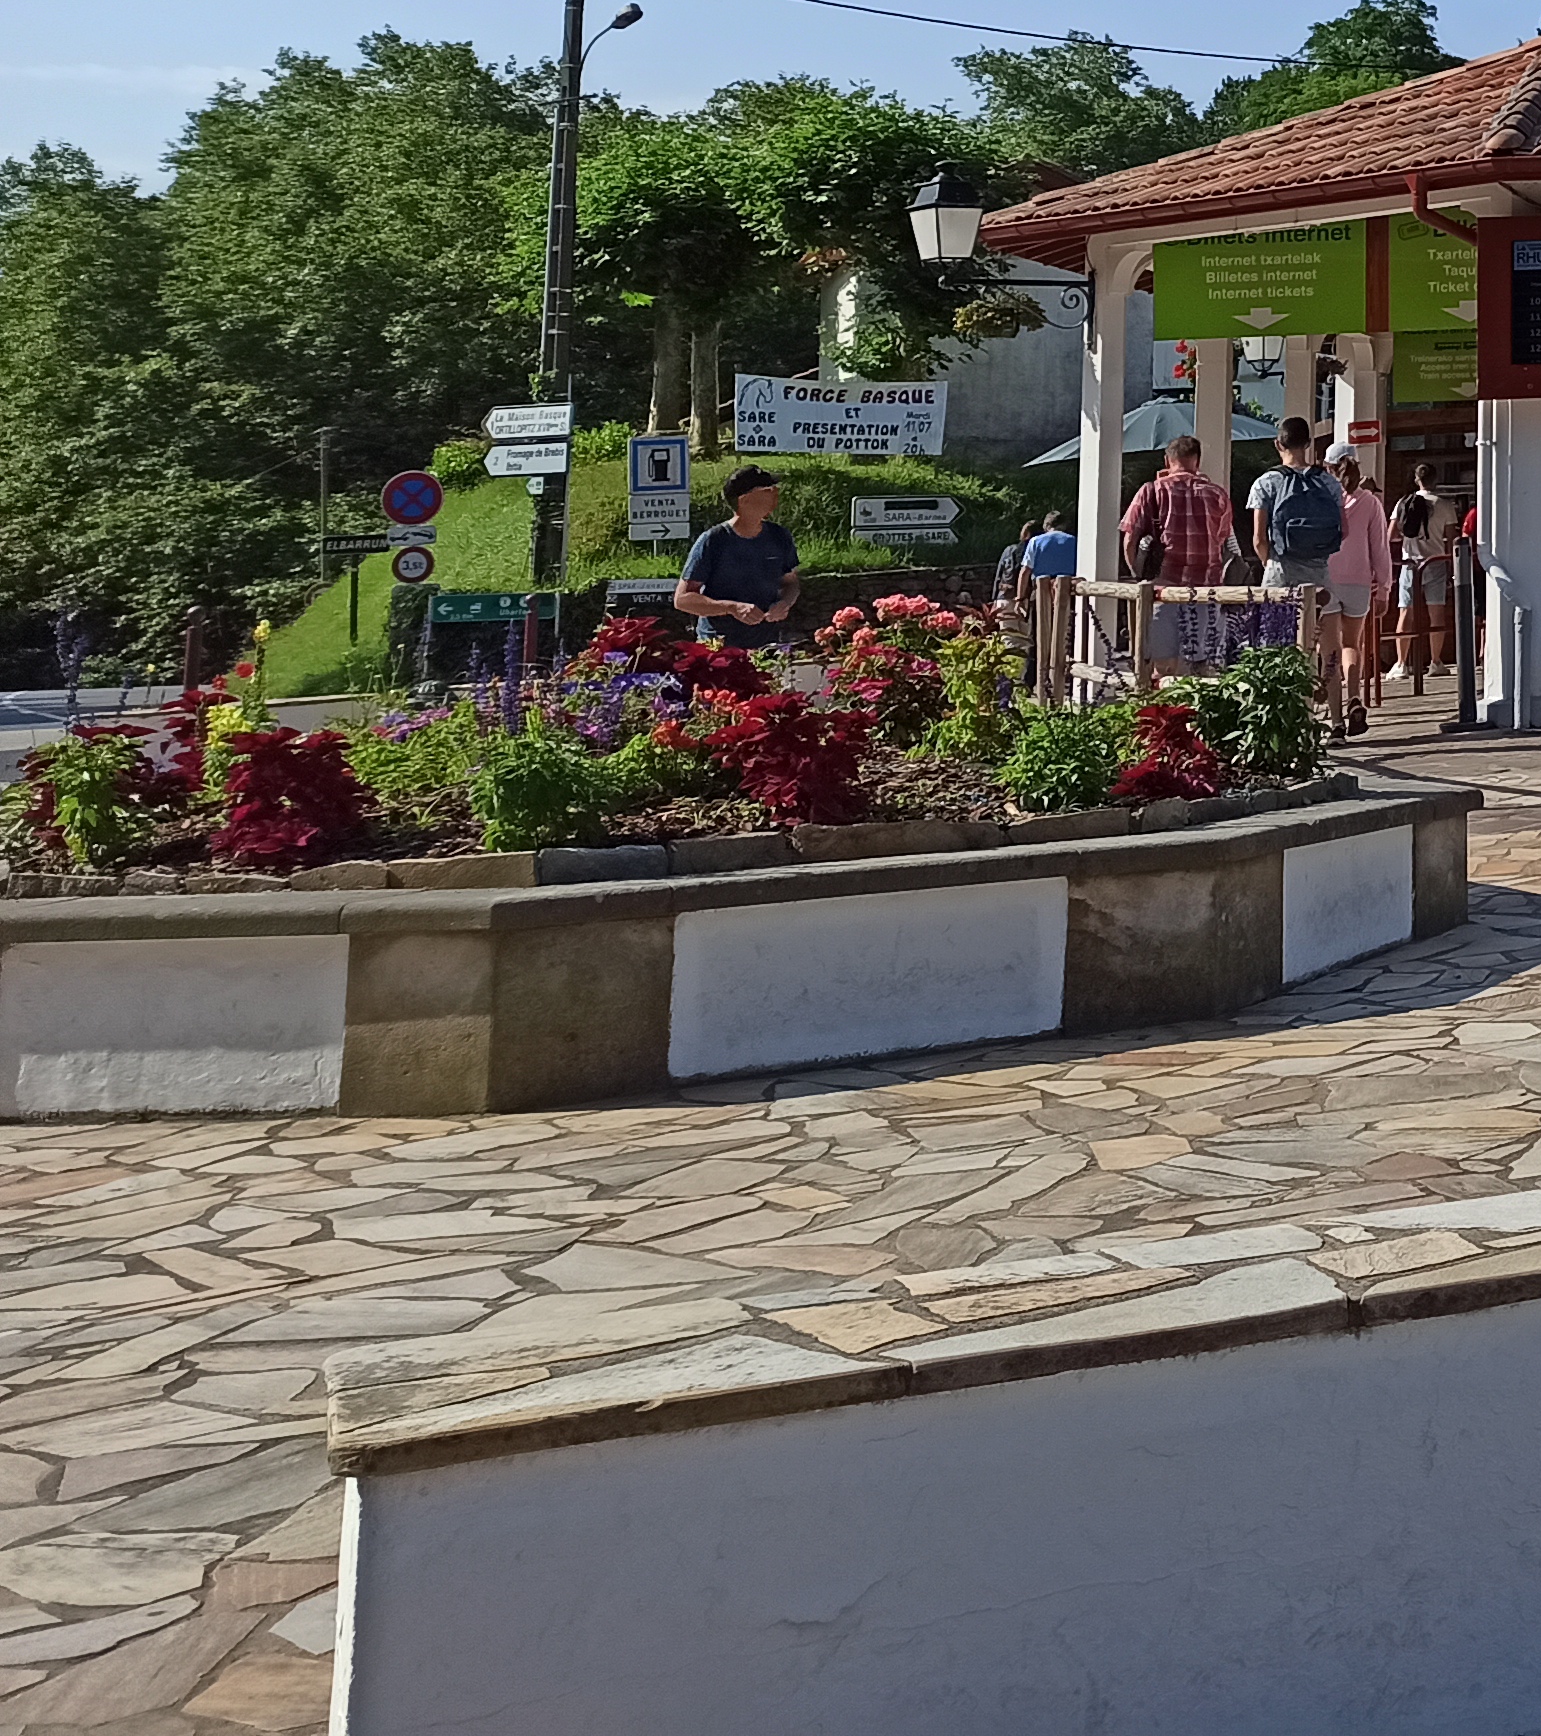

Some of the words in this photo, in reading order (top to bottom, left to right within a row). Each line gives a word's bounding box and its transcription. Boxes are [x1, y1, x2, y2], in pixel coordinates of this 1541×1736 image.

[1201, 255, 1256, 267] Internet
[1261, 252, 1321, 265] txartelak
[1206, 271, 1259, 284] Billetes
[1263, 269, 1317, 282] internet
[1209, 287, 1263, 300] Internet
[1267, 285, 1315, 298] tickets
[1428, 281, 1470, 294] Ticket
[783, 385, 848, 403] FORCE
[860, 389, 935, 405] BASQUE
[507, 411, 535, 421] Maison
[538, 409, 567, 421] Basque
[738, 411, 776, 424] SARE
[844, 407, 861, 419] ET
[906, 411, 931, 420] Mardi
[792, 421, 899, 437] PRESENTATION
[737, 434, 777, 447] SARA
[806, 436, 825, 449] DU
[834, 437, 889, 450] POTTOK
[643, 499, 676, 507] VENTA
[632, 509, 688, 519] BERROUET
[633, 594, 662, 603] VENTA
